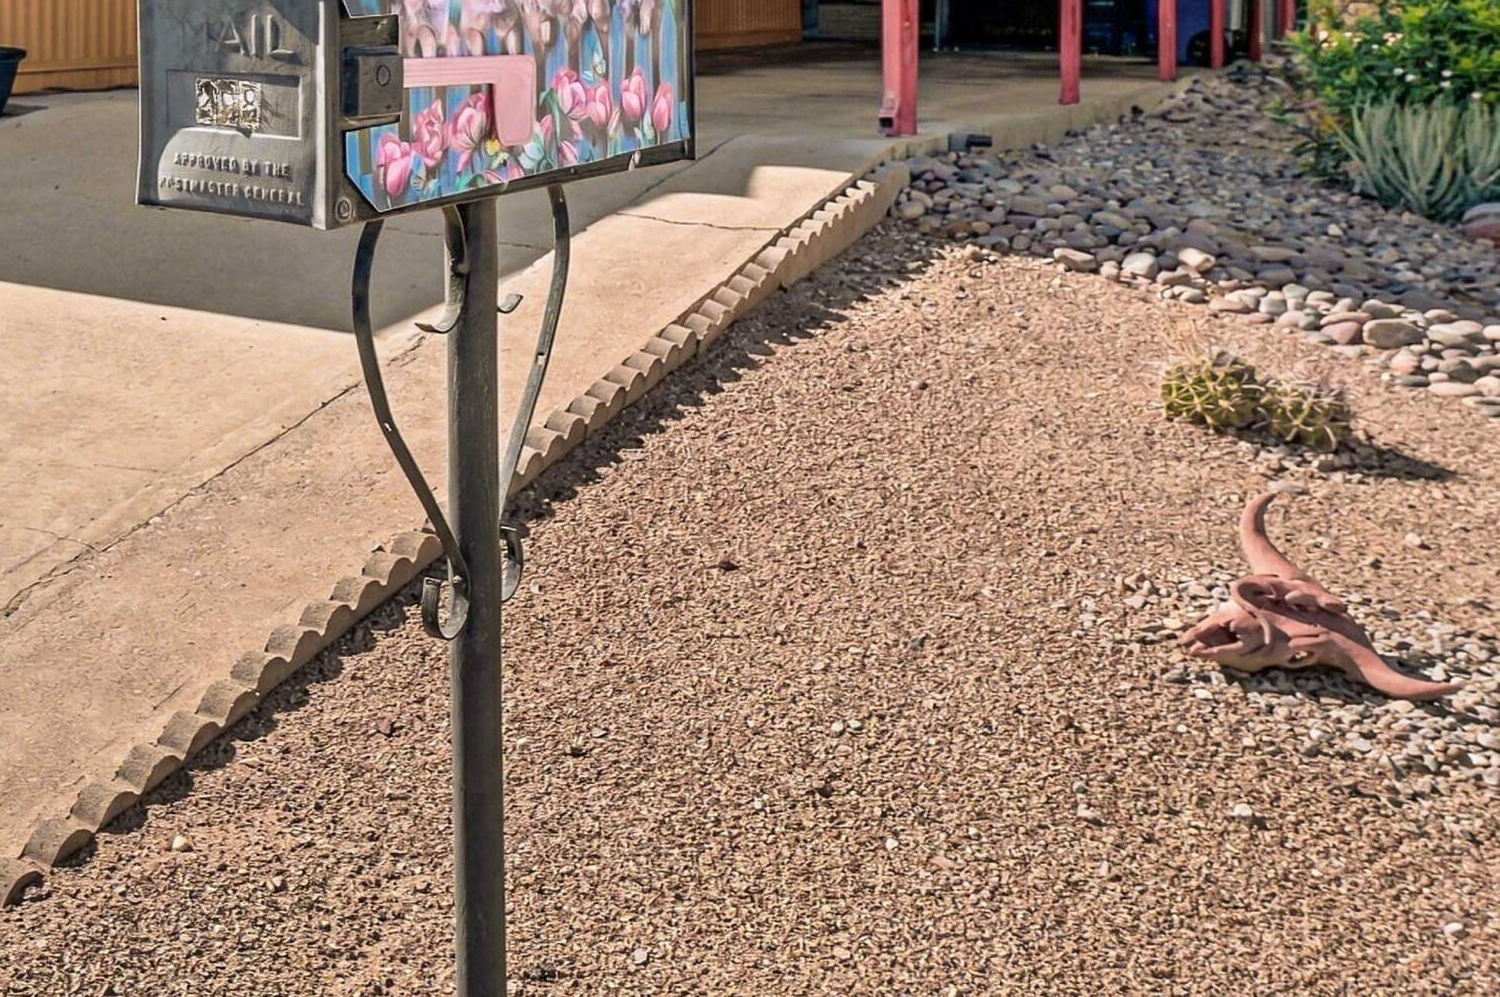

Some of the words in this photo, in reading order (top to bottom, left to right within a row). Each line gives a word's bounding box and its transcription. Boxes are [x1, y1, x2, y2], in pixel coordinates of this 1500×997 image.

[174, 152, 239, 173] APPROVED
[242, 158, 259, 174] BY
[264, 161, 290, 177] THE
